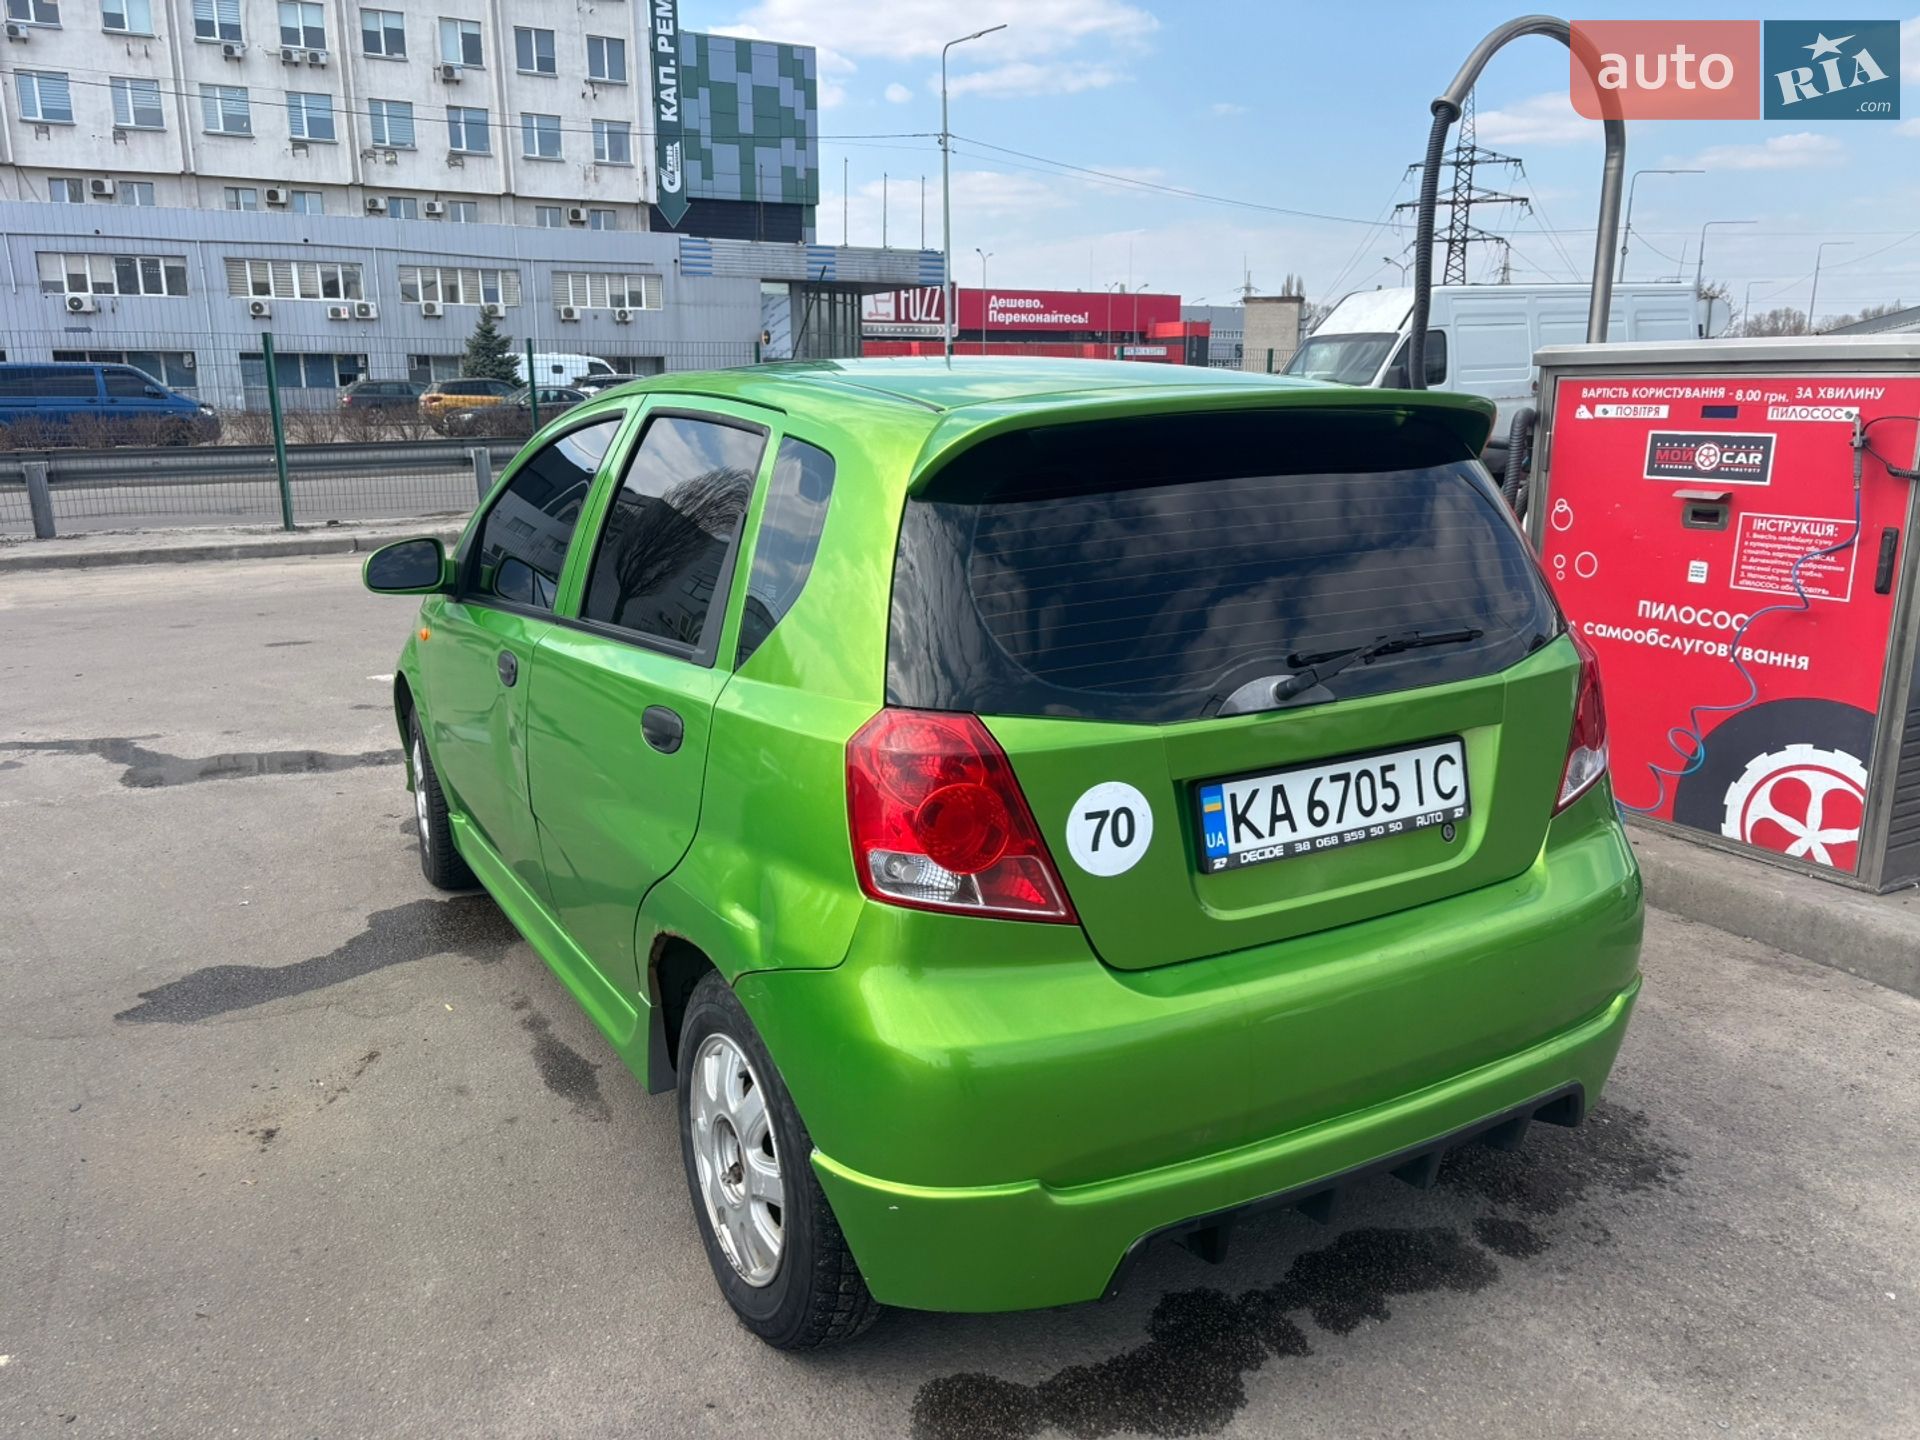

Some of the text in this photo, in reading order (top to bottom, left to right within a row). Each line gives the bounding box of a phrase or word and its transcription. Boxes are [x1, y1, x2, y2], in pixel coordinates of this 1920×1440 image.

[659, 59, 678, 122] КАП.
[988, 295, 1044, 309] Дешево.
[988, 310, 1089, 325] Переконайтесь!
[1581, 387, 1630, 399] ВАРТІСТЬ
[1632, 386, 1726, 399] КОРИСТУВАННЯ
[1763, 391, 1790, 404] грн.
[1795, 386, 1813, 399] ЗА
[1816, 386, 1886, 400] ХВИЛИНУ
[1615, 406, 1661, 417] ПОВІТРЯ
[1769, 407, 1845, 420] ПИЛОСОС
[1721, 452, 1764, 465] CAR
[1752, 518, 1839, 537] ІНСТРУКЦІЯ:
[1638, 600, 1749, 632] ПИЛОСОС
[1583, 621, 1809, 671] самообслуговування
[1229, 754, 1460, 844] KA 6705 IC
[1084, 806, 1136, 852] 70
[1240, 844, 1284, 864] DECIDE
[1294, 841, 1311, 852] 38
[1315, 835, 1339, 848] 068
[1370, 825, 1385, 837] 50
[1388, 821, 1403, 832] 50
[1416, 811, 1444, 827] AUTO
[1206, 831, 1226, 848] UA
